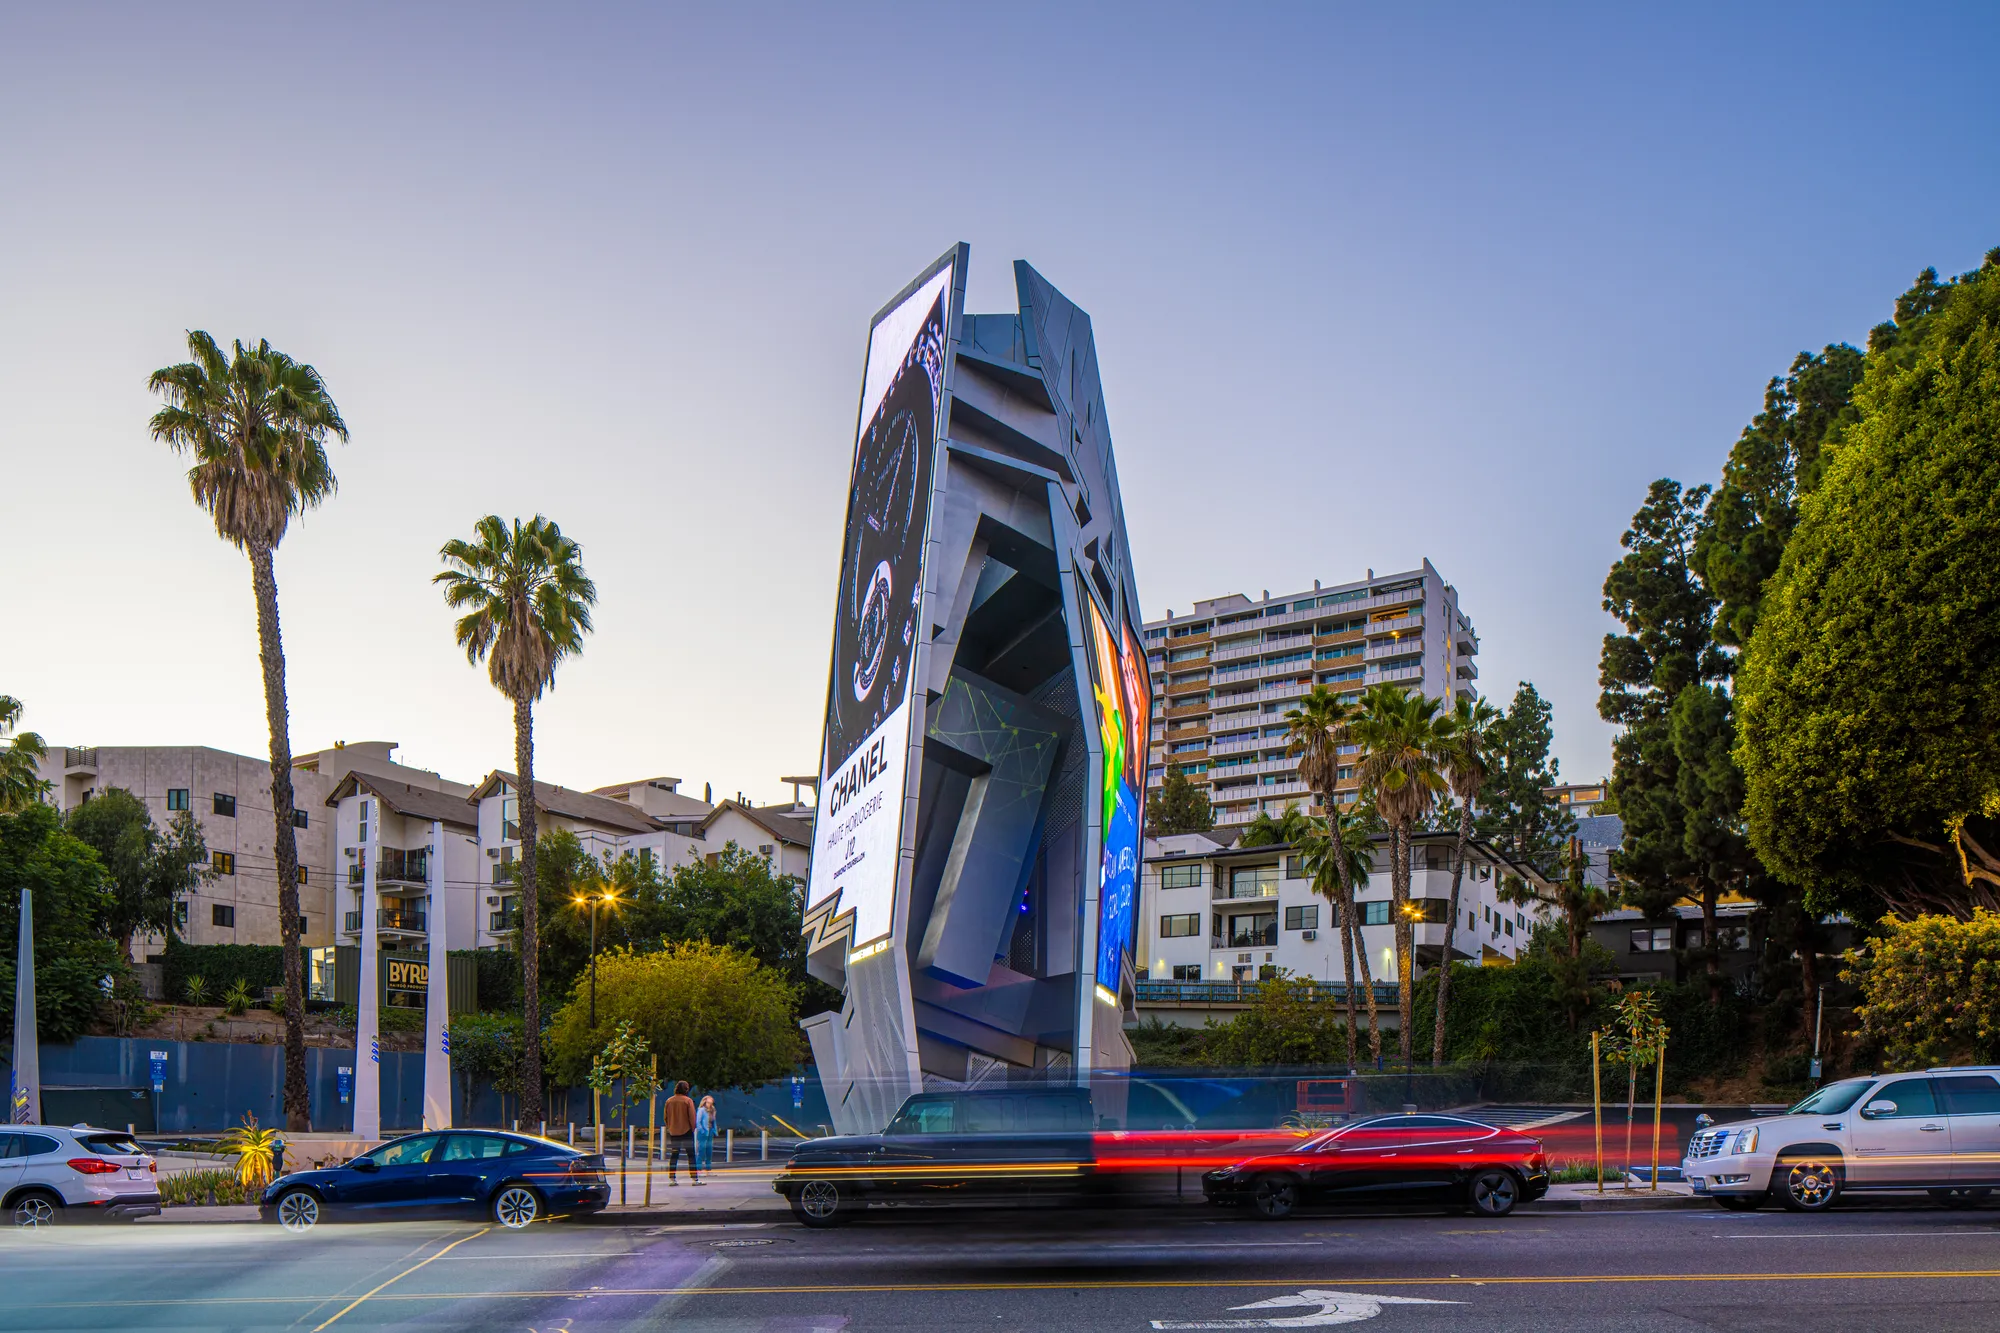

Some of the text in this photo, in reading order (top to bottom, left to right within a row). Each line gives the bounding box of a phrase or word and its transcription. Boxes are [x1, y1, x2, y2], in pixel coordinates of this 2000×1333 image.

[830, 736, 888, 817] CHANEL
[827, 791, 883, 850] HAUTE HORLOGERIE
[845, 836, 856, 860] J12
[389, 962, 429, 984] BYRD
